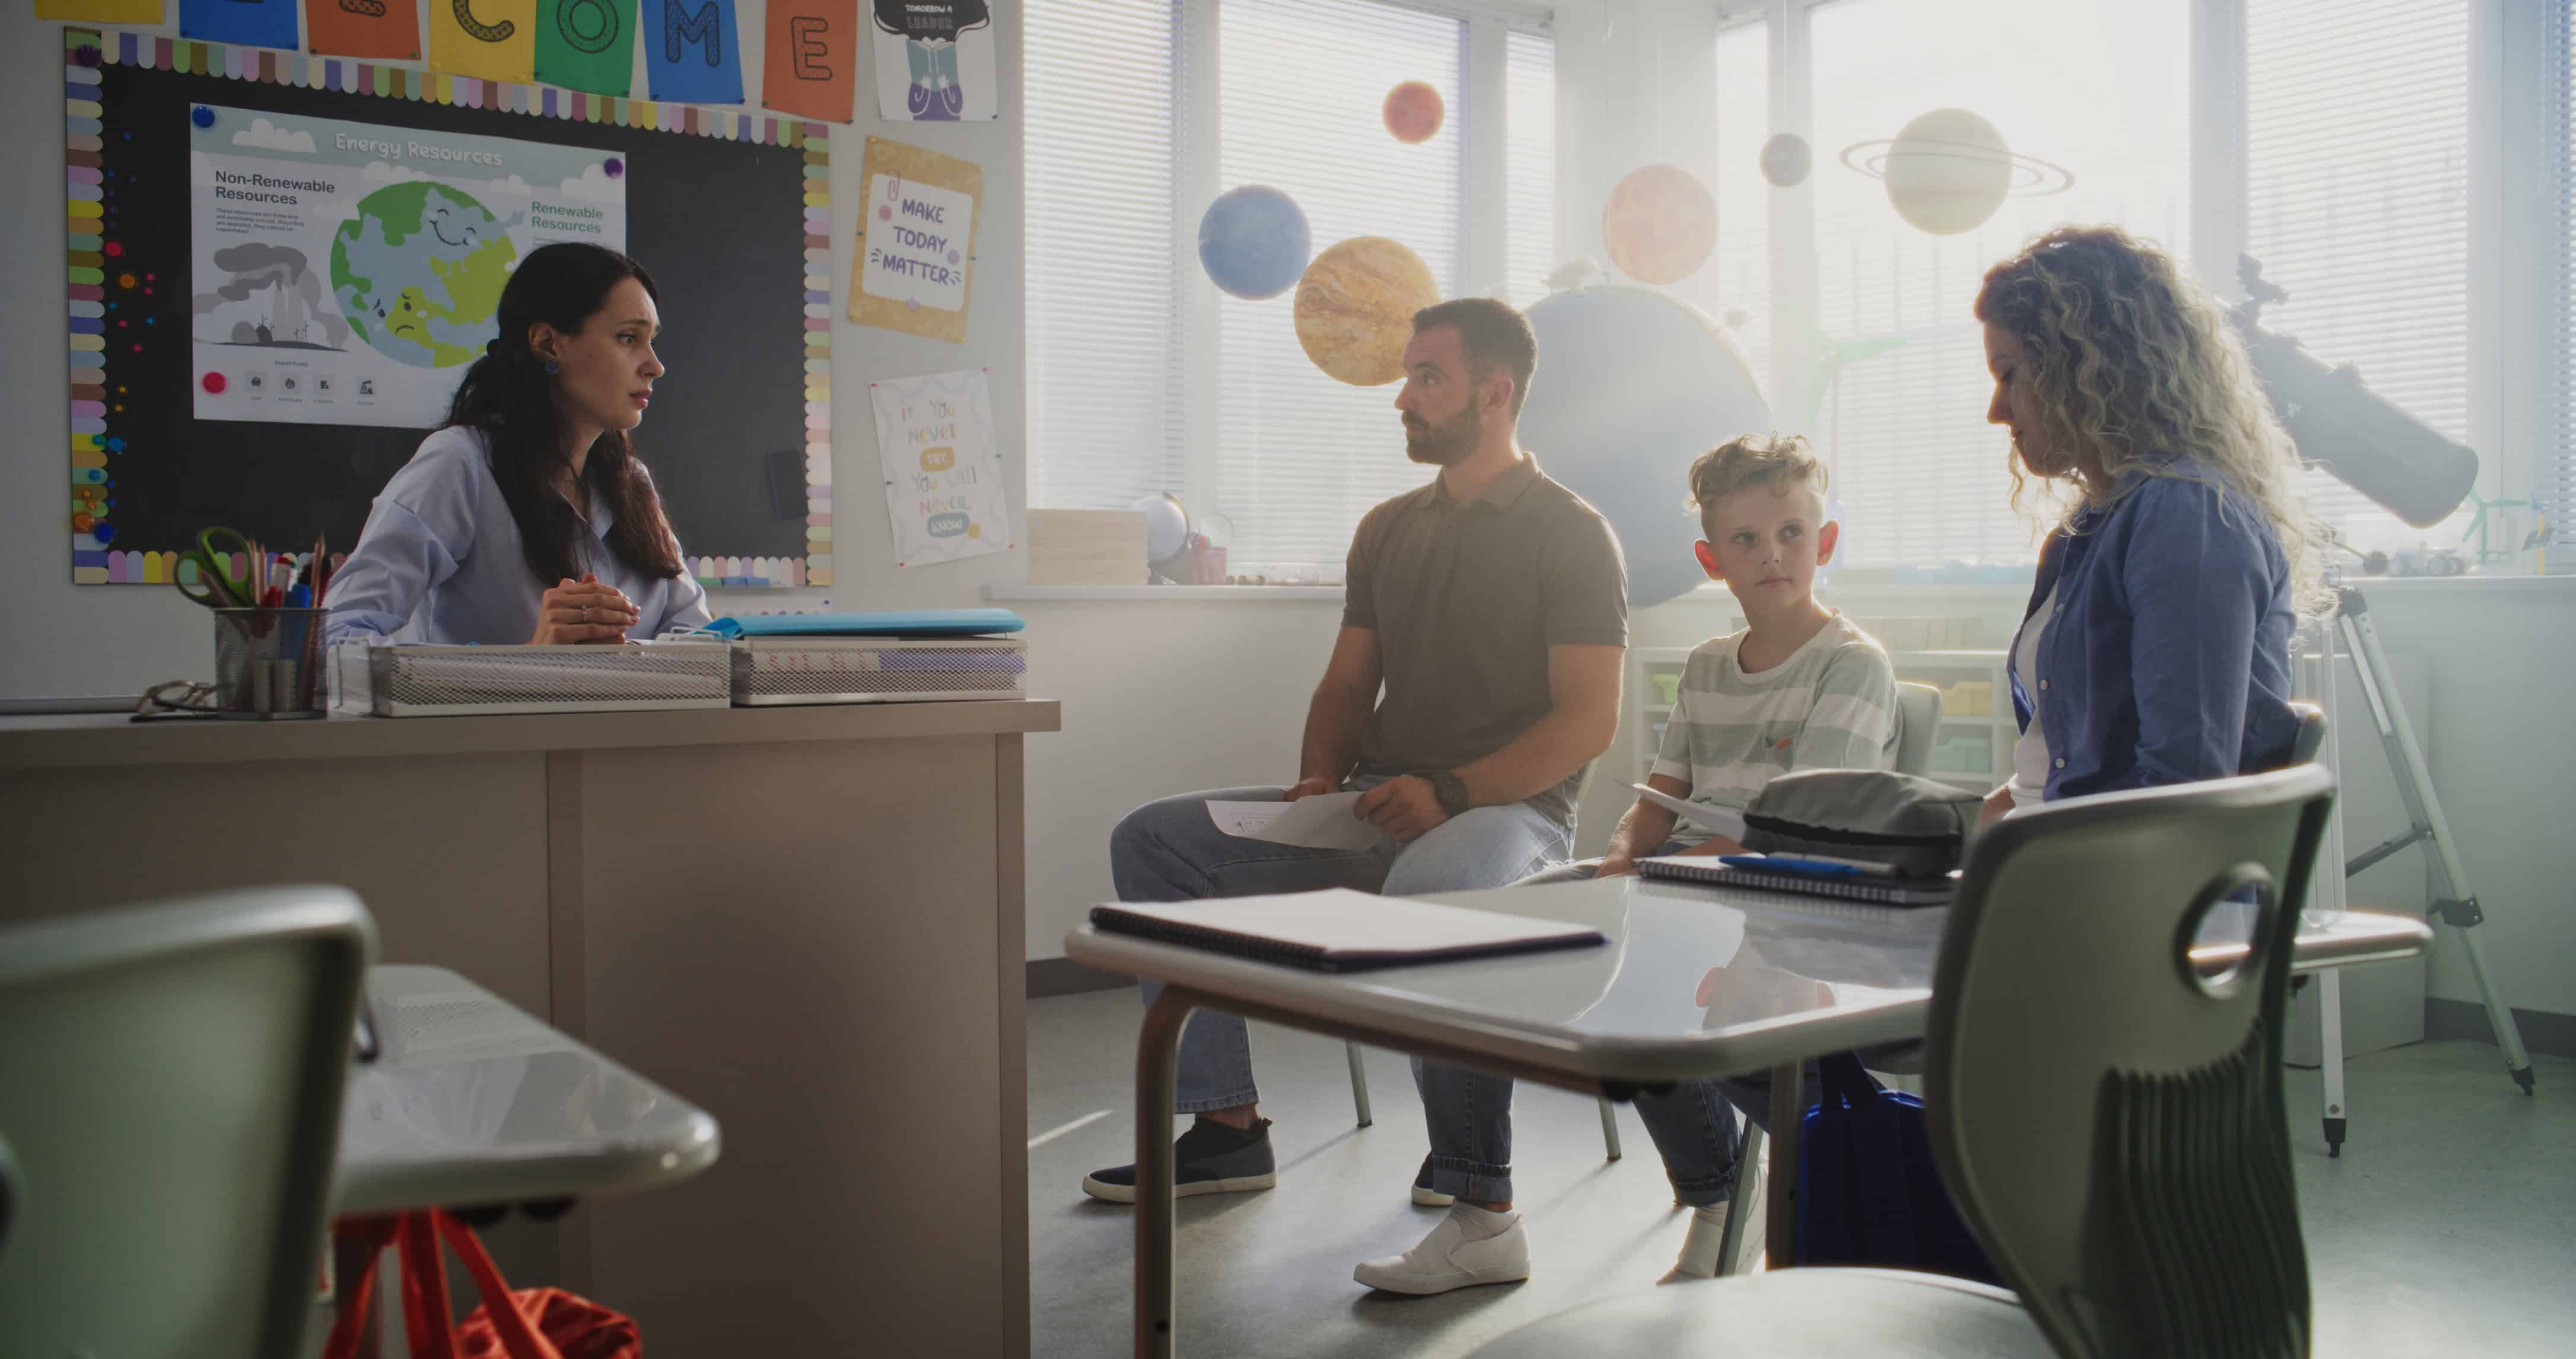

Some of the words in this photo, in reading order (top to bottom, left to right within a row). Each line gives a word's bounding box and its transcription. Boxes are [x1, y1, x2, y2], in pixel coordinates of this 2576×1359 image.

[335, 132, 401, 160] Energy
[408, 141, 503, 166] Resources
[215, 170, 335, 193] Non-Renewable
[215, 186, 298, 205] Resources
[531, 200, 603, 219] Renewable
[901, 198, 945, 224] MAKE
[531, 216, 601, 233] Resources
[893, 226, 948, 254] TODAY
[882, 254, 949, 285] MATTER
